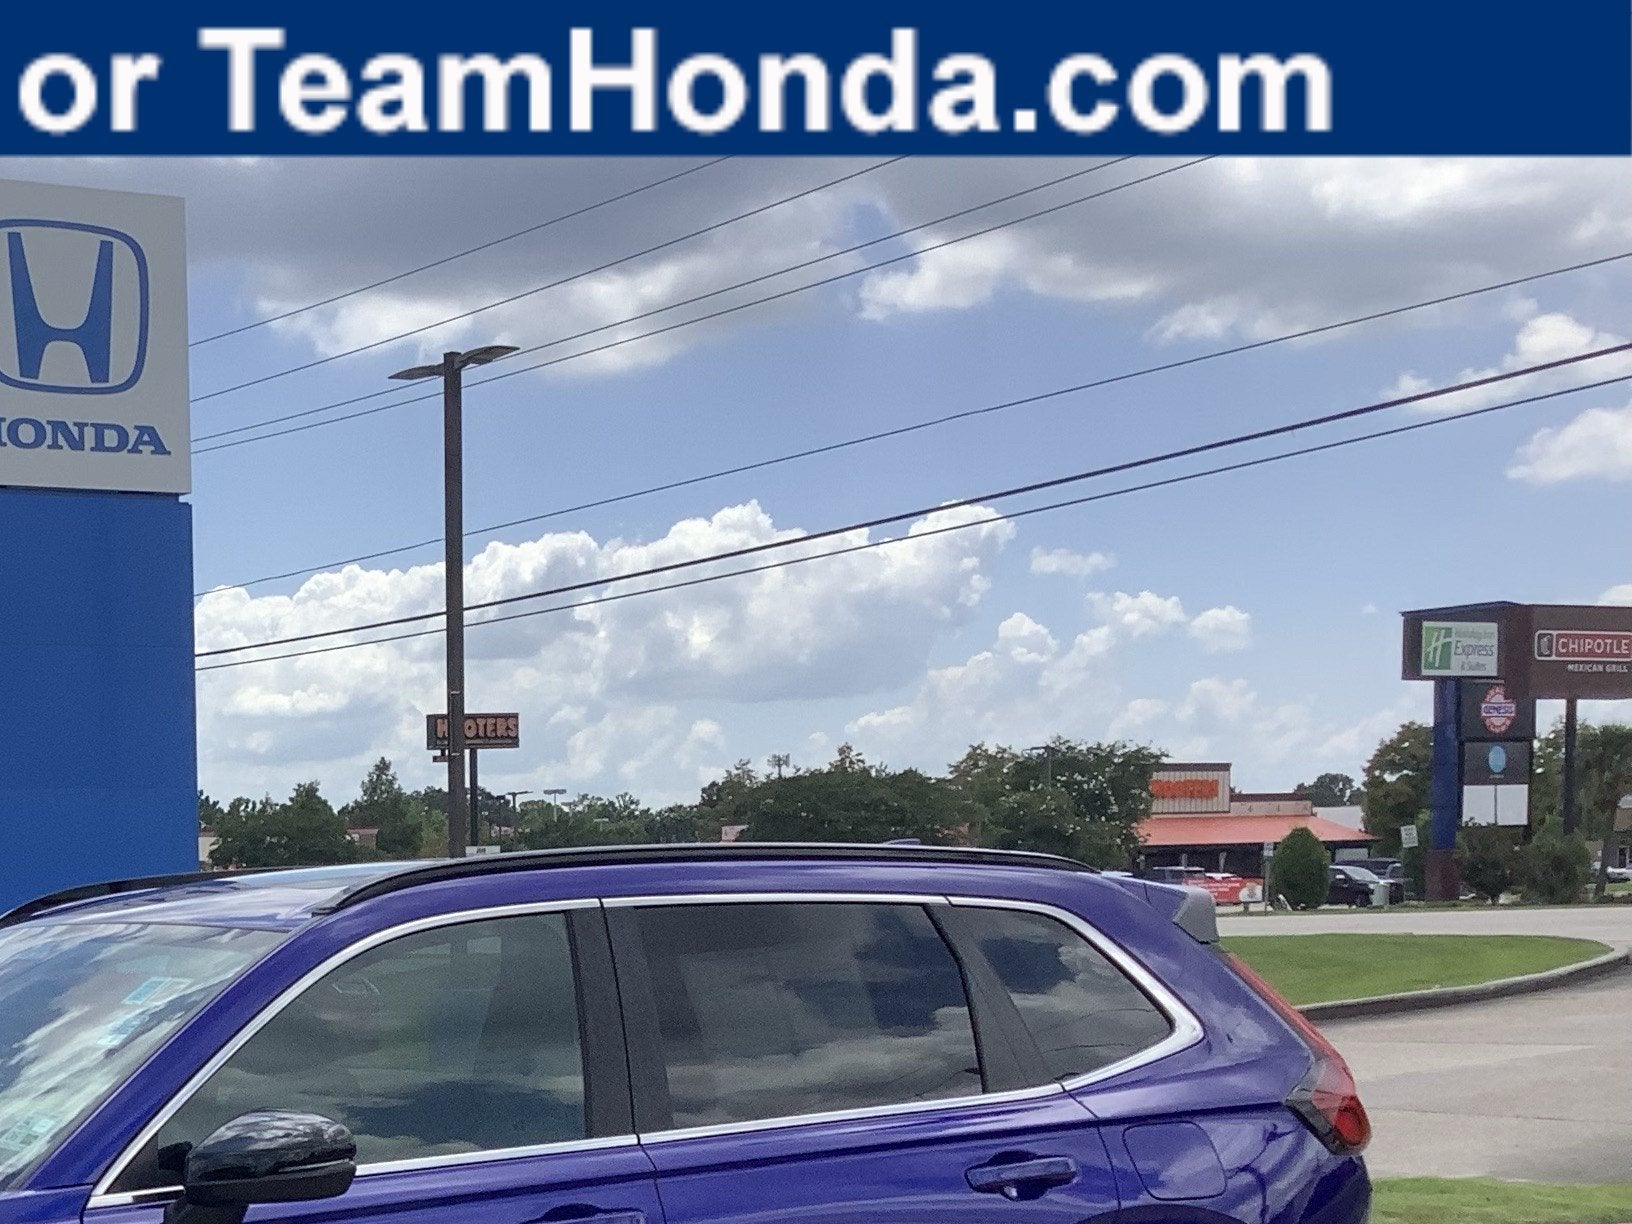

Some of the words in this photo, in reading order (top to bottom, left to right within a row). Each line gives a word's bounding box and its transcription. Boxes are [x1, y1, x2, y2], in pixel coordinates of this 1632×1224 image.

[1454, 640, 1496, 659] Express
[1558, 638, 1630, 654] CHIPOTLE
[1568, 663, 1604, 673] MEXICAN
[1606, 664, 1629, 673] GRILL
[436, 717, 518, 738] HOTERS
